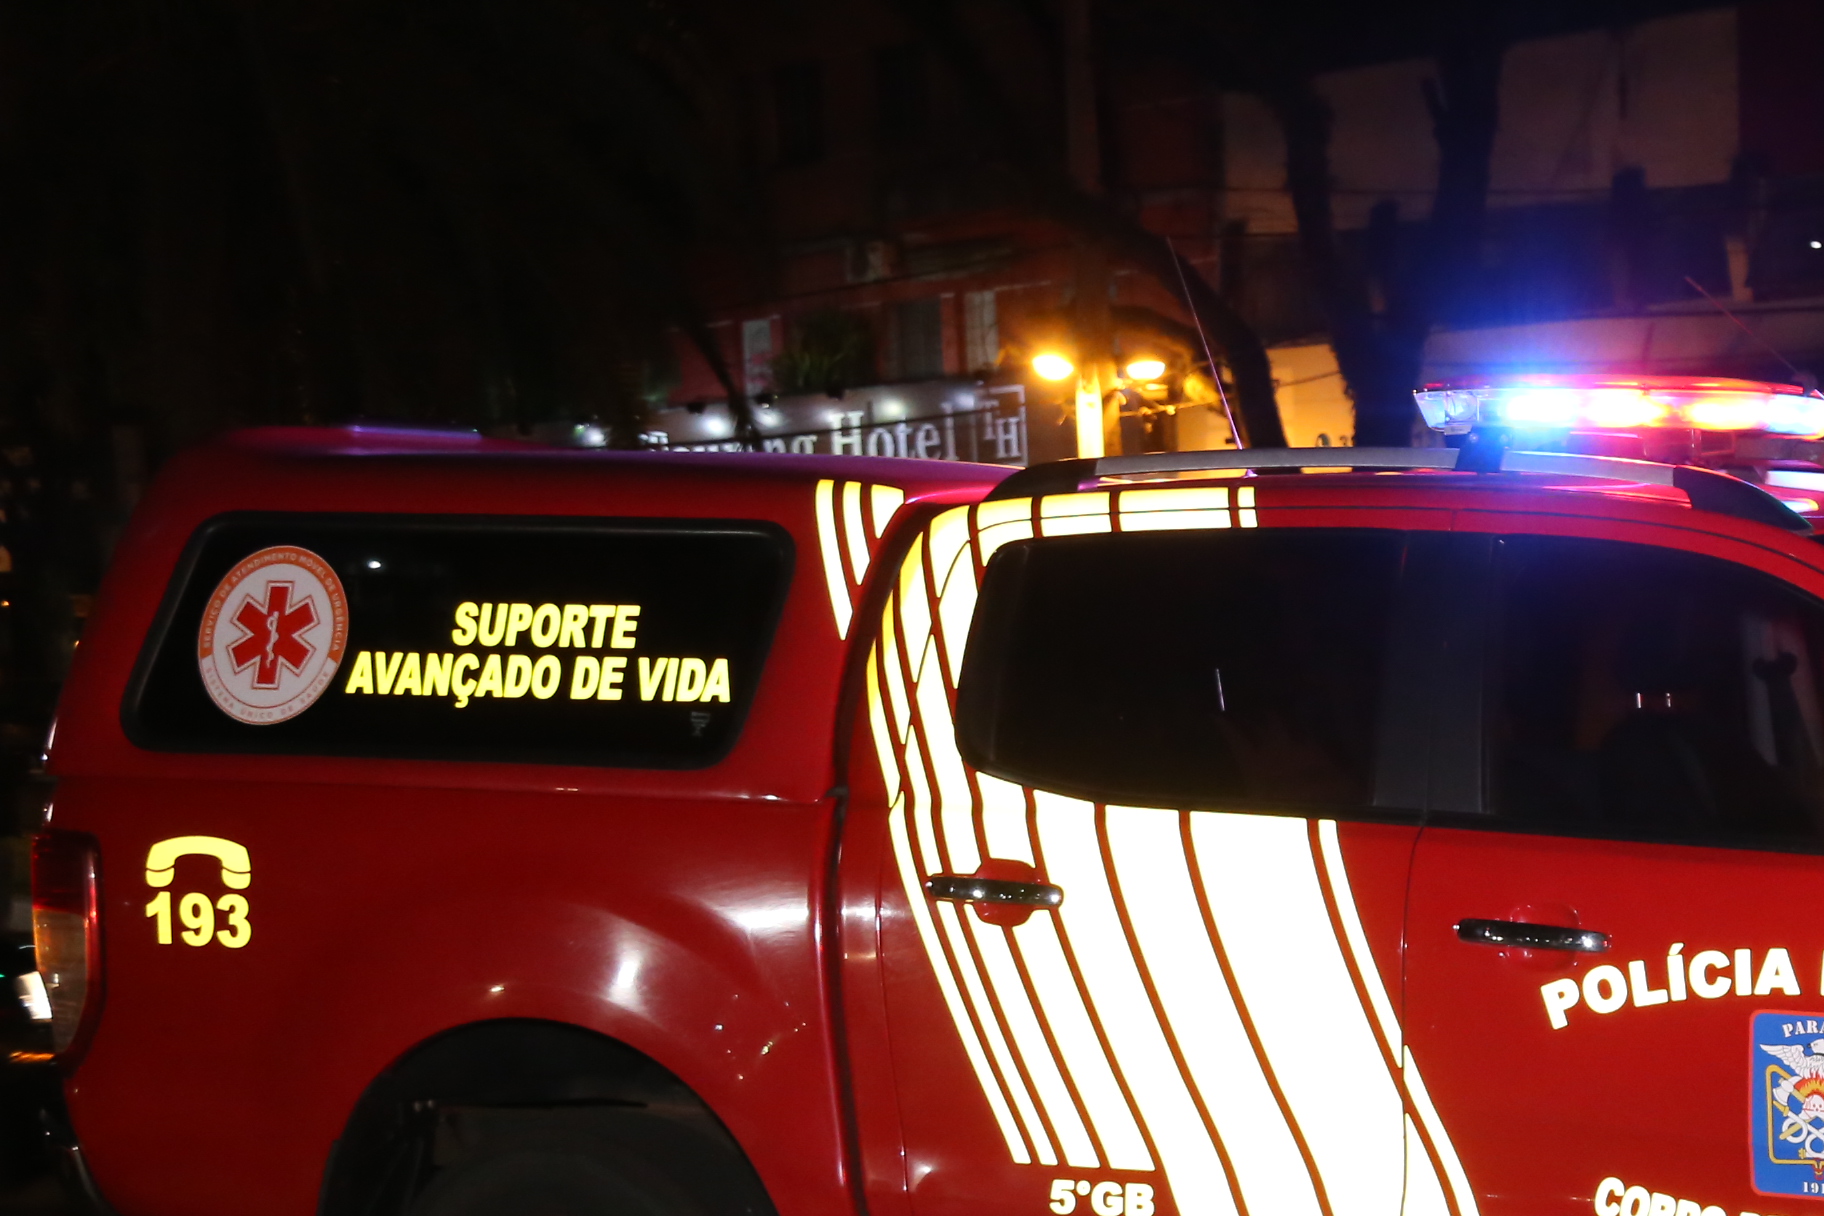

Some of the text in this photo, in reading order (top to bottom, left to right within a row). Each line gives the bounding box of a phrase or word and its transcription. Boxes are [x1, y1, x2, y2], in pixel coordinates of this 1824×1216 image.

[830, 402, 959, 461] Hotel
[231, 551, 297, 585] ATENDIMENTO
[298, 553, 326, 580] MÓVEL
[452, 602, 641, 648] SUPORTE
[345, 652, 731, 708] AVANÇADO DE VIDA
[145, 891, 251, 949] 193
[1540, 942, 1801, 1030] POLÍCIA
